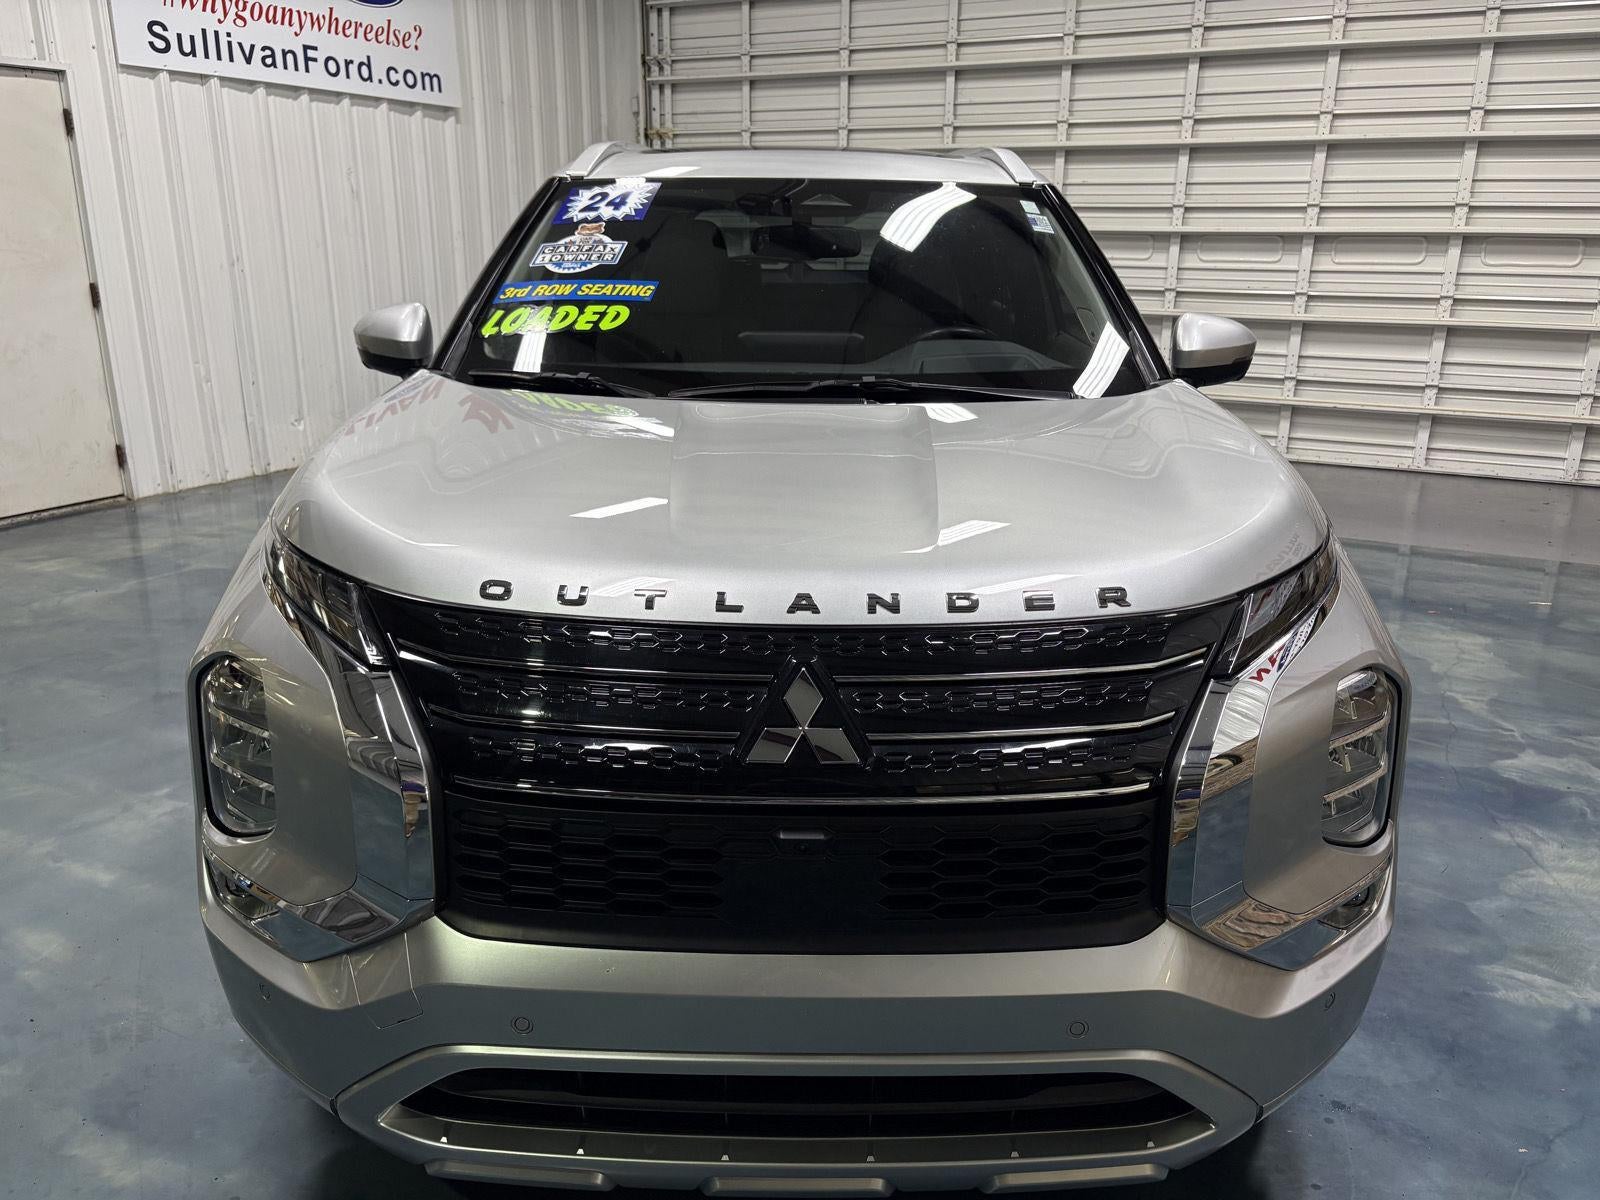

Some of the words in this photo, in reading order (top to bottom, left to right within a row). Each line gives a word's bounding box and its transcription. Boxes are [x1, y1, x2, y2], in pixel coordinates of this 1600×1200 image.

[163, 0, 423, 50] wygoanywhereelse?
[147, 20, 443, 93] SullivanFord.com
[578, 190, 634, 213] 24
[543, 244, 618, 254] CARFAX
[500, 286, 532, 299] 3rd
[532, 284, 577, 298] ROW
[579, 283, 655, 297] SEATING
[481, 304, 631, 337] LOADED
[479, 578, 1132, 614] OUTLANDER
